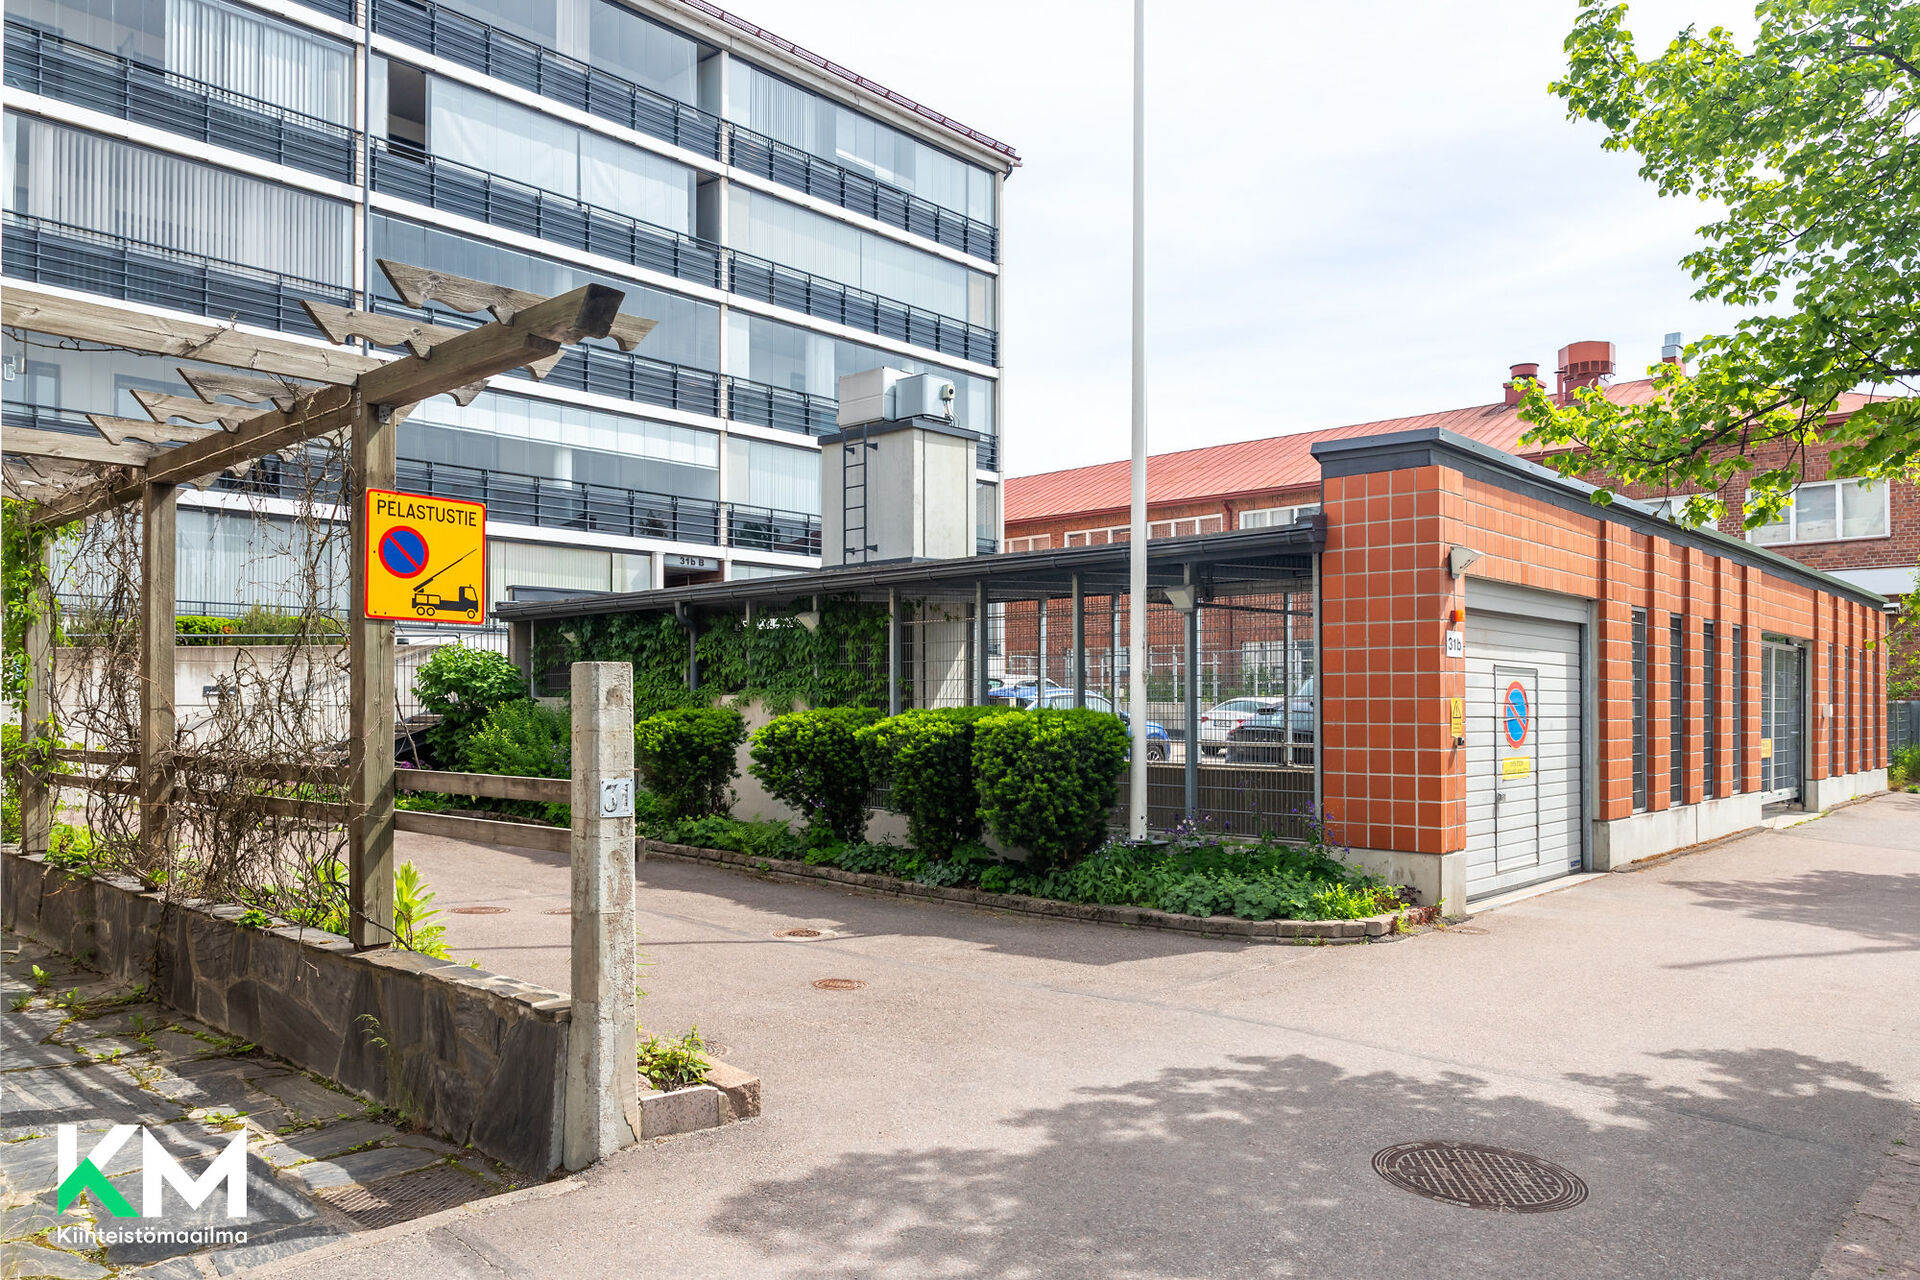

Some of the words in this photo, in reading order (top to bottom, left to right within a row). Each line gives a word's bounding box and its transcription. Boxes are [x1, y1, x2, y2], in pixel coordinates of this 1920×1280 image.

[376, 499, 477, 527] PELASTUSTIE
[679, 556, 696, 566] 31b
[698, 558, 705, 567] B
[1448, 637, 1462, 652] 31b
[604, 783, 630, 813] 31
